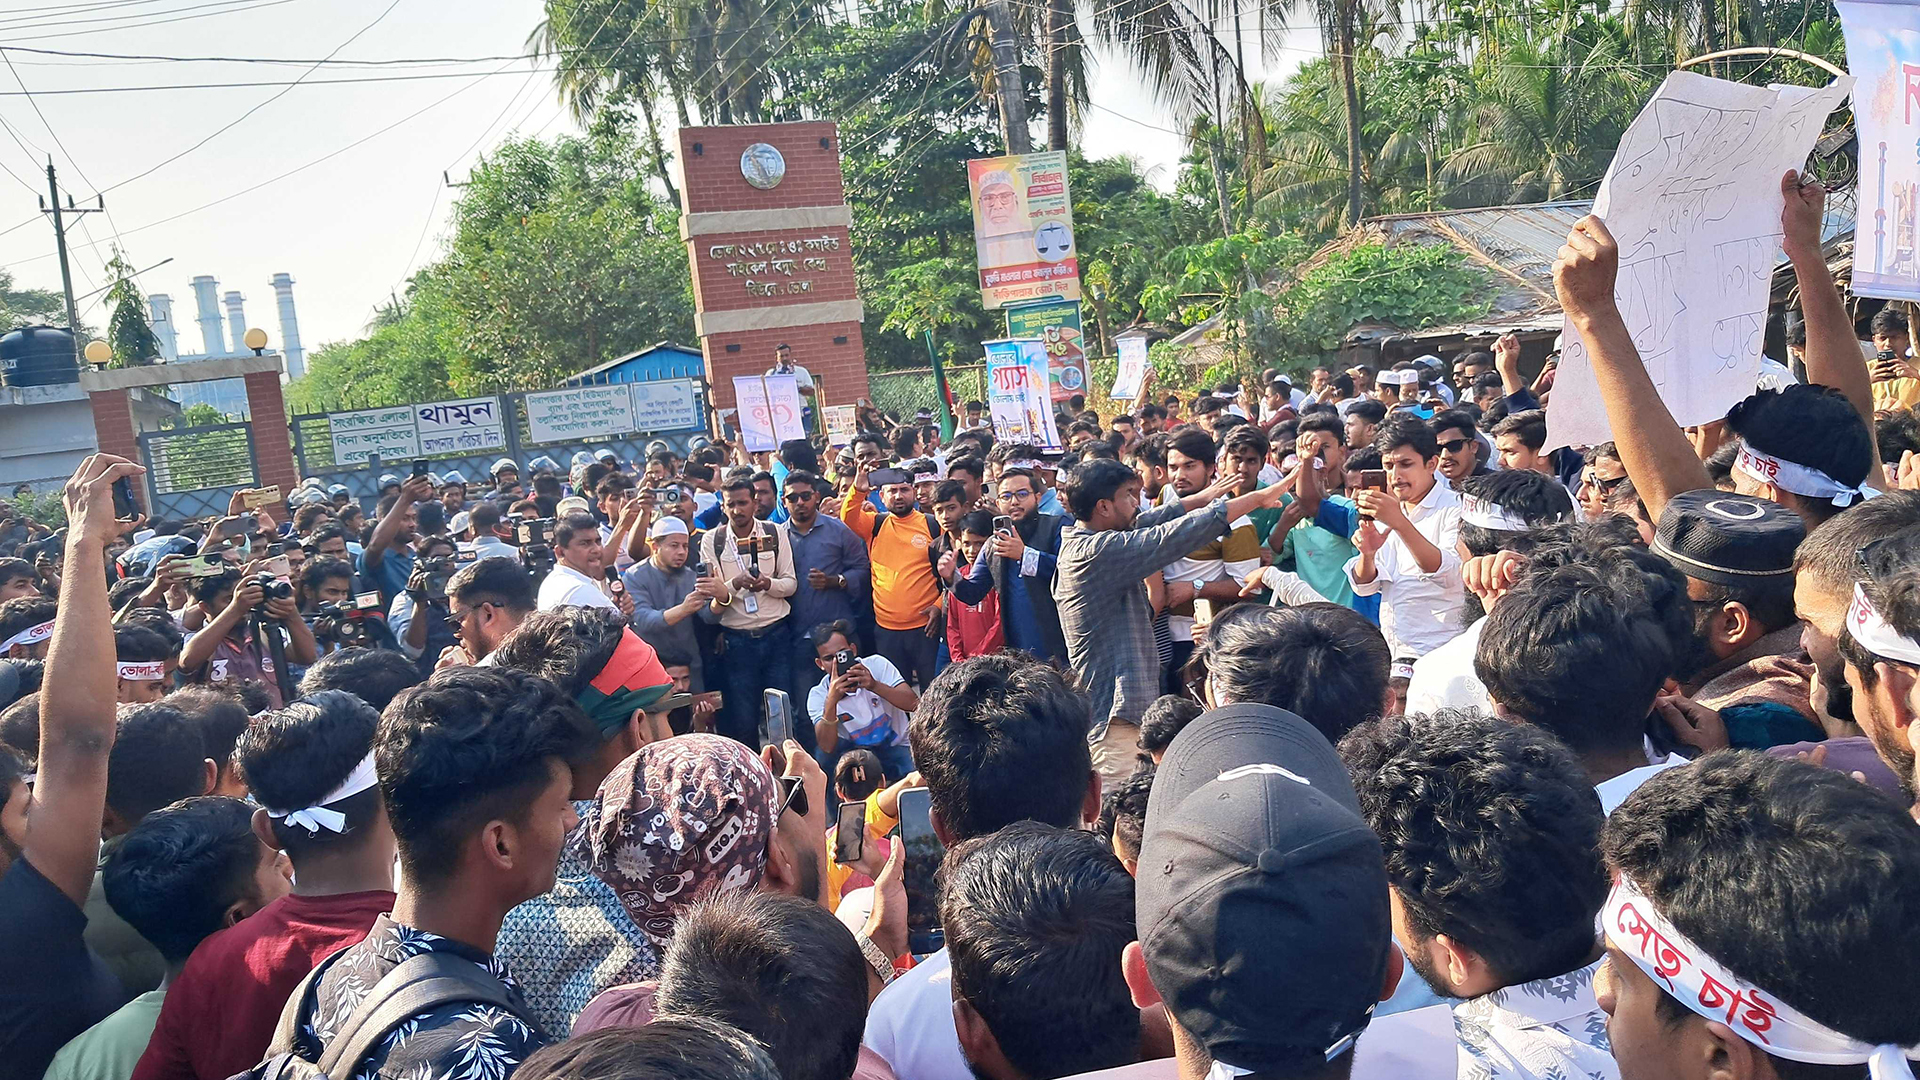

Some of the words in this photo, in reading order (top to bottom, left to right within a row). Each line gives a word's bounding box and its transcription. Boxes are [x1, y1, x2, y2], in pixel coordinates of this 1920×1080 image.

[709, 244, 738, 259] ভোলা
[726, 260, 768, 277] সাইকেল
[787, 280, 814, 295] ভোলা
[992, 366, 1029, 391] গ্যাস
[419, 402, 494, 426] থামুন
[566, 403, 580, 411] এবং
[332, 413, 376, 429] সংরক্ষিত
[379, 411, 411, 424] এলাকা
[335, 434, 358, 446] বিনা
[361, 428, 413, 444] অনুমতিতে
[423, 437, 455, 451] আপনার
[484, 428, 499, 446] দিন
[1754, 456, 1781, 483] চাই
[211, 659, 228, 681] 3
[709, 822, 740, 858] NO.1
[1617, 902, 1692, 993] সেতু
[1699, 968, 1785, 1046] চাই
